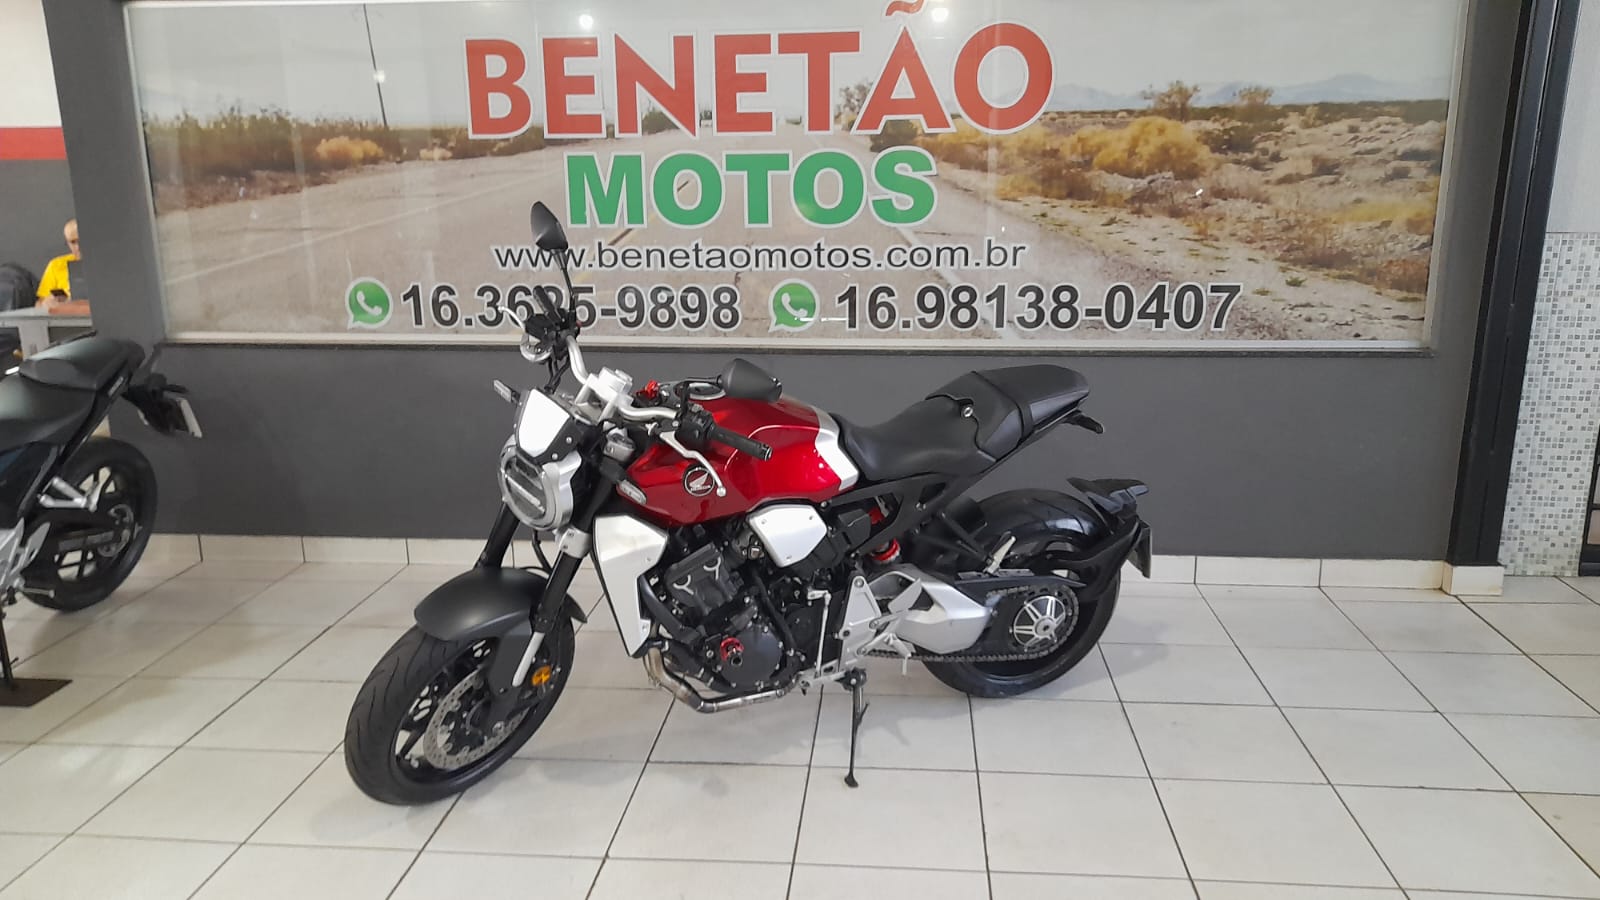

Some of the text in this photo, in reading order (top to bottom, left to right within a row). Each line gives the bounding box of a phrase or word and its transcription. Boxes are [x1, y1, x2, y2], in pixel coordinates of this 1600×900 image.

[465, 0, 1054, 136] BENETÃO
[566, 150, 936, 226] MOTOS
[837, 283, 1242, 330] 16.98138-0407
